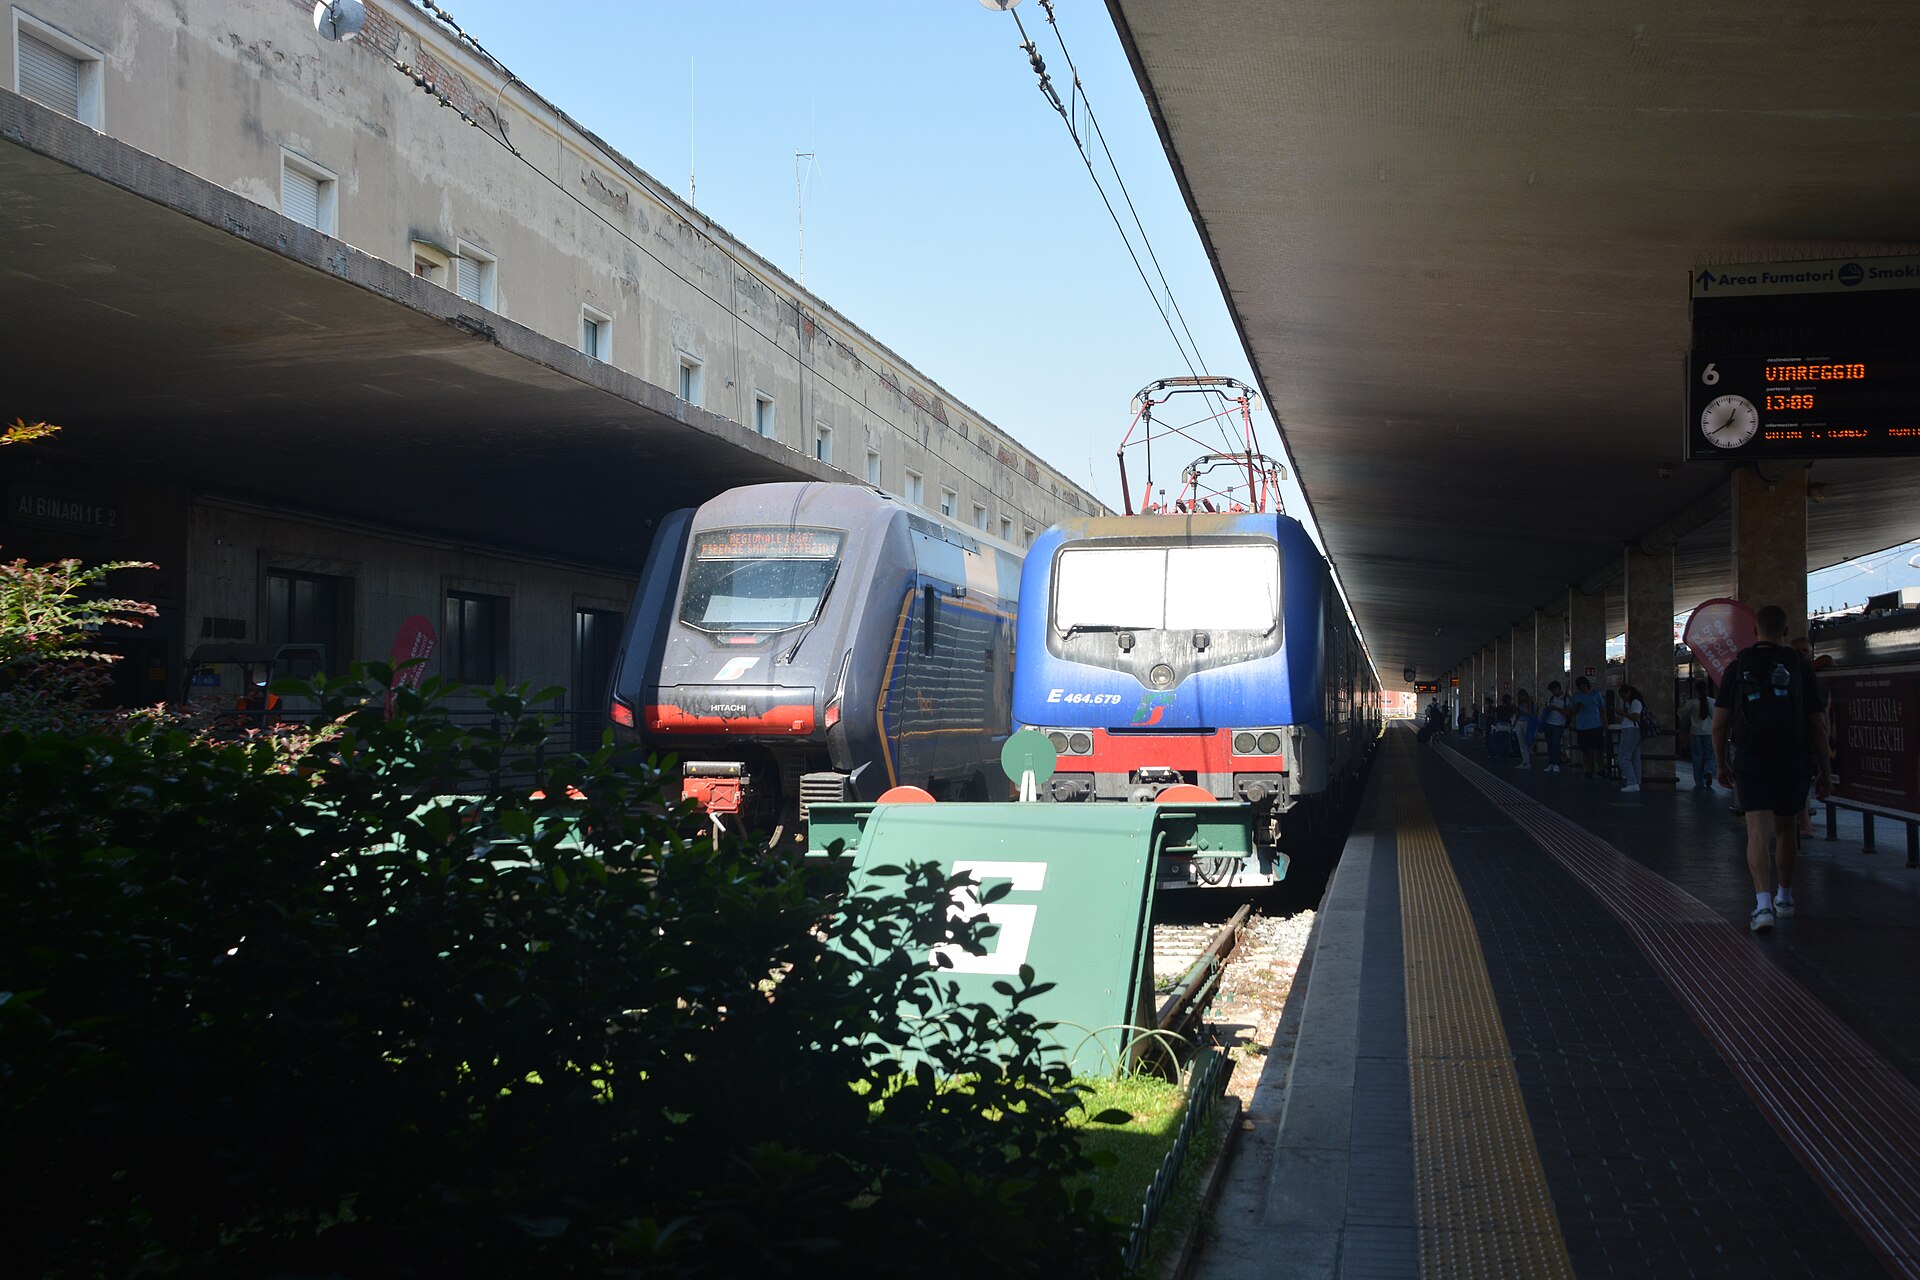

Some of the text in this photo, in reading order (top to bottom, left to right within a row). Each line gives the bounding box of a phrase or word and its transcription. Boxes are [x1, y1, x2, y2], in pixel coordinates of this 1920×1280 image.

[1718, 273, 1757, 286] Area
[1761, 269, 1834, 284] Fumatori
[1701, 362, 1720, 386] 6
[1765, 364, 1866, 381] VIAREGGIO
[1765, 394, 1815, 411] 13:09
[729, 532, 782, 545] REGIONALE
[1047, 689, 1121, 705] E 464.679
[710, 704, 747, 712] HITACHI
[1852, 697, 1899, 723] ARTEMISIA
[1848, 724, 1905, 752] GENTILESCHI
